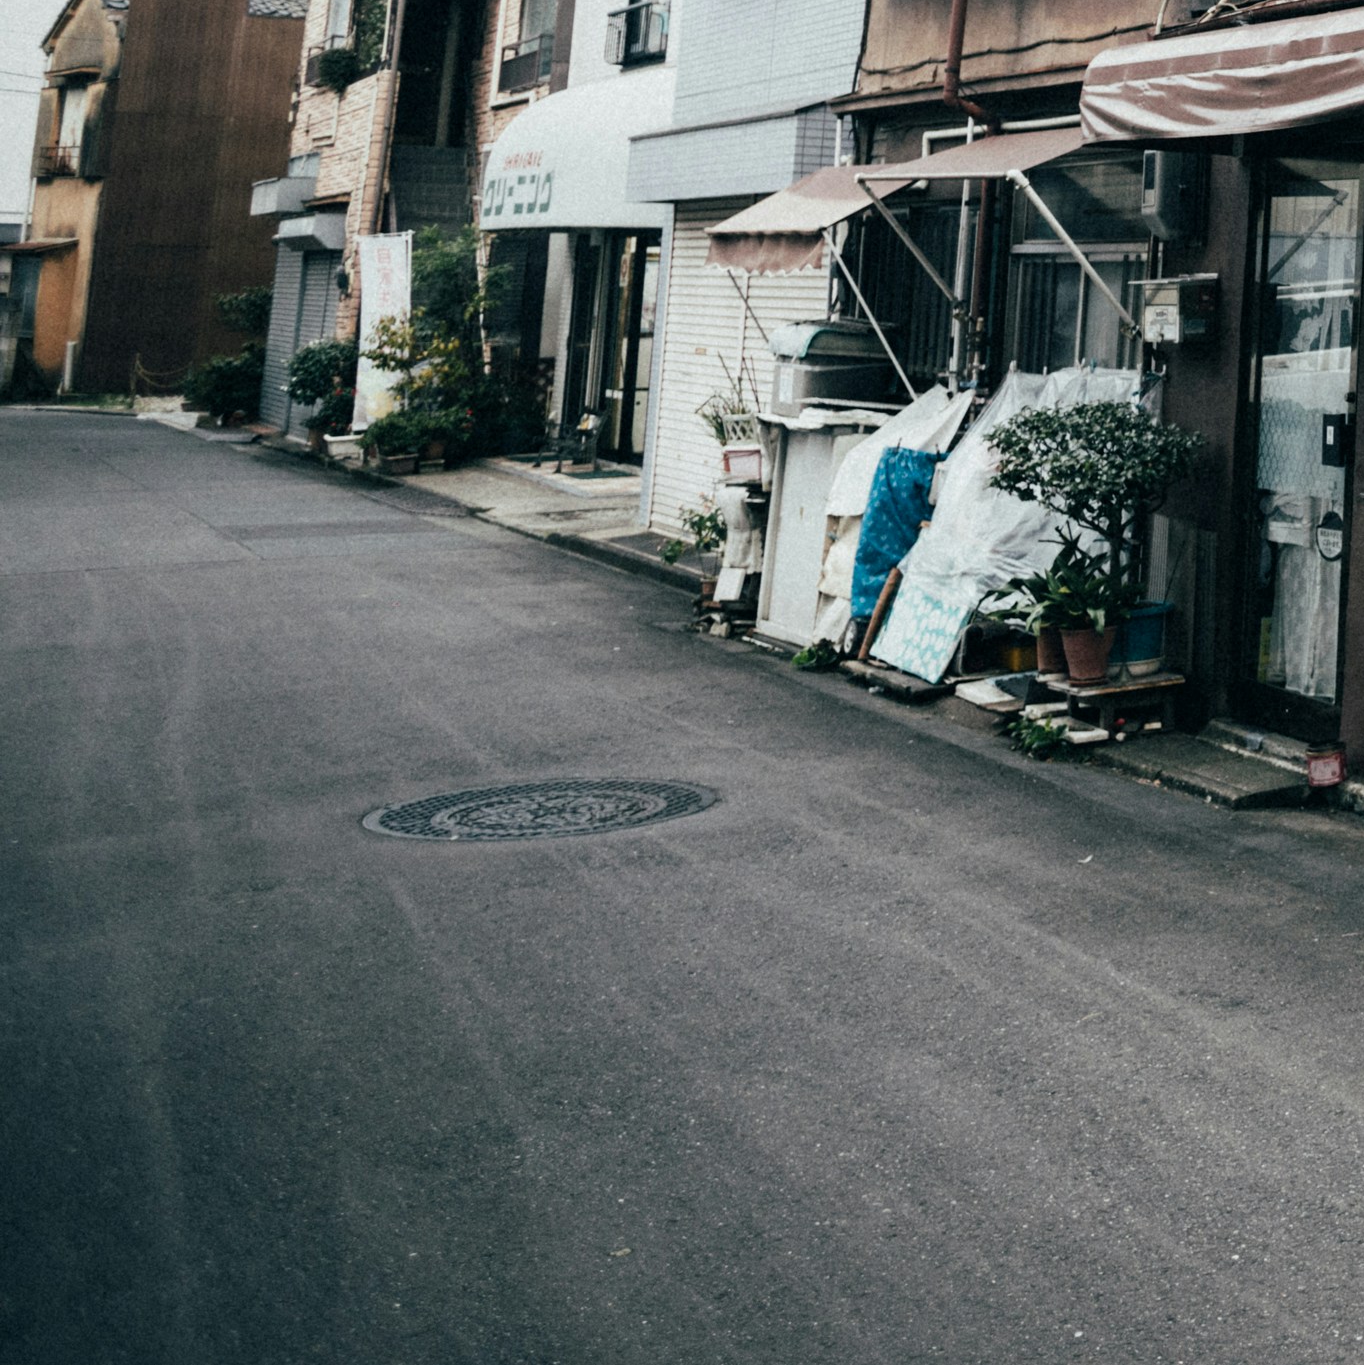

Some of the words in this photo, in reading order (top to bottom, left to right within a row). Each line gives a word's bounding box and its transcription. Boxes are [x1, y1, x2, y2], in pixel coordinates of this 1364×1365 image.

[483, 170, 554, 217] クリーニング
